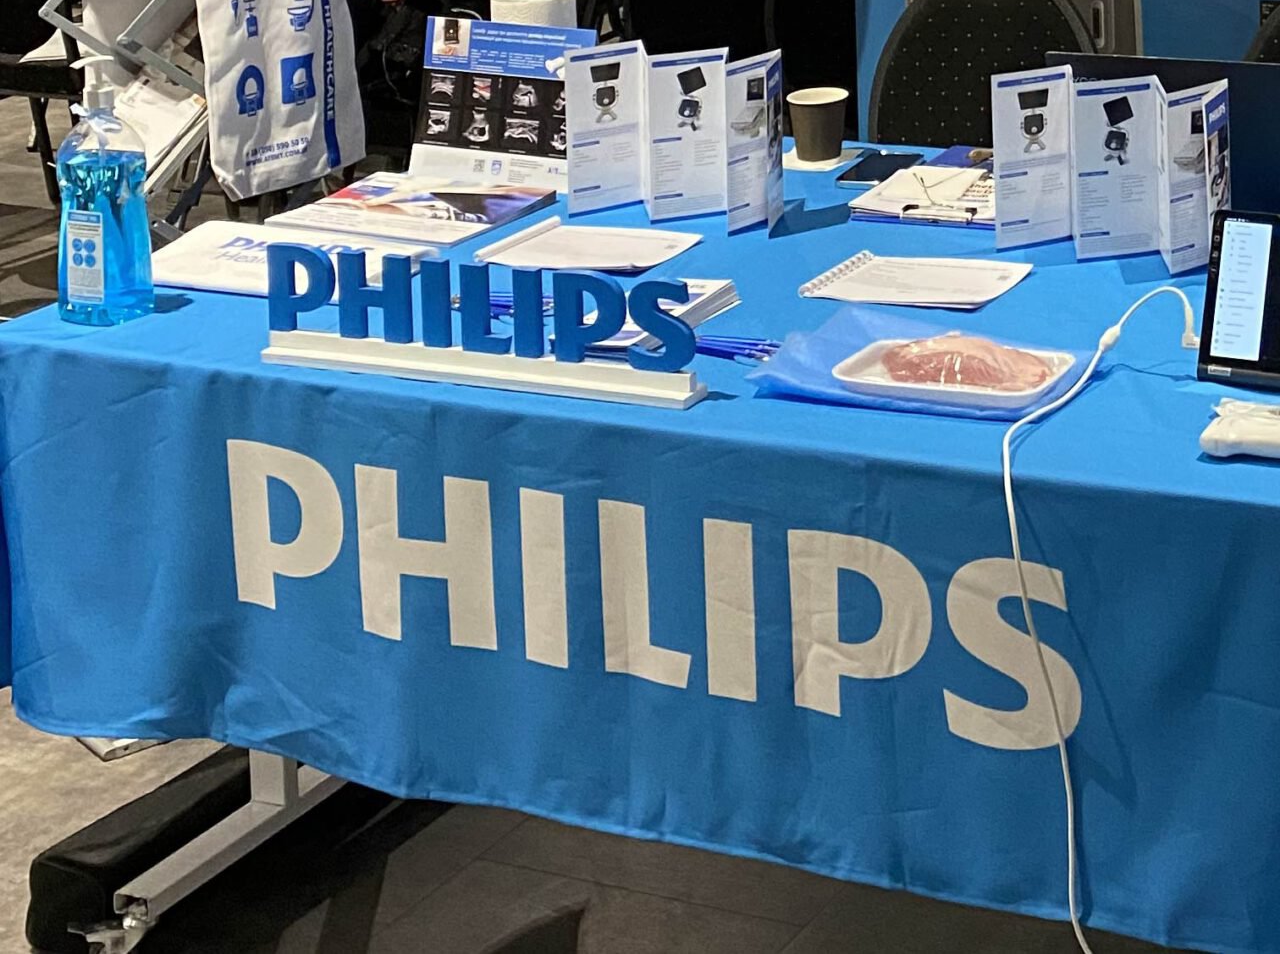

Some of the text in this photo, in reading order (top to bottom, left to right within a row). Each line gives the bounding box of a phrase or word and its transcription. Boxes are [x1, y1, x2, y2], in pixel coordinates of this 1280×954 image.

[323, 4, 335, 121] HEALTHCARE
[267, 244, 698, 373] PHILIPS
[226, 438, 1083, 751] PHILIPS
